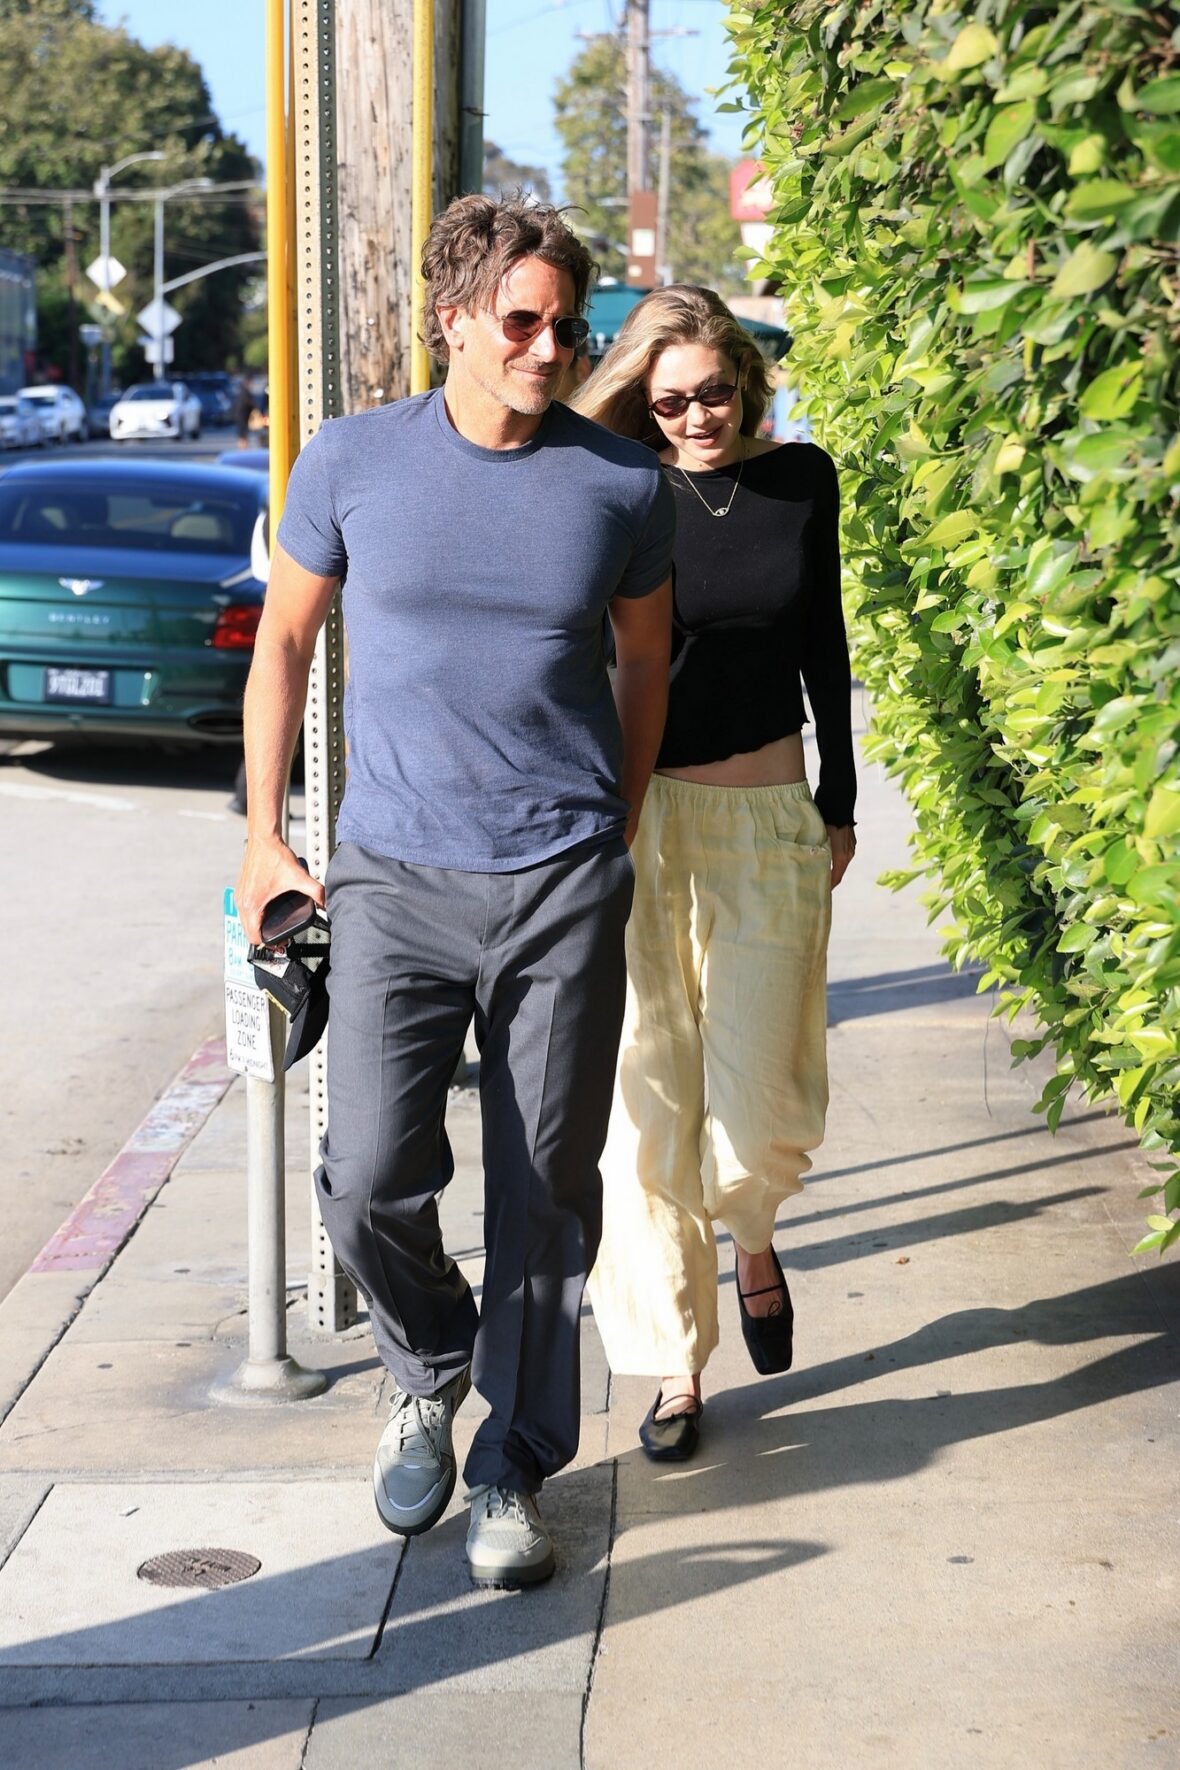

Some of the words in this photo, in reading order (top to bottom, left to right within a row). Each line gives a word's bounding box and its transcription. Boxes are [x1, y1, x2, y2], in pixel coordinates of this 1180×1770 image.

[48, 612, 111, 625] BENTLEY
[226, 987, 265, 1012] PASSENGER
[232, 1009, 261, 1032] LOADING
[237, 1030, 257, 1050] ZONE
